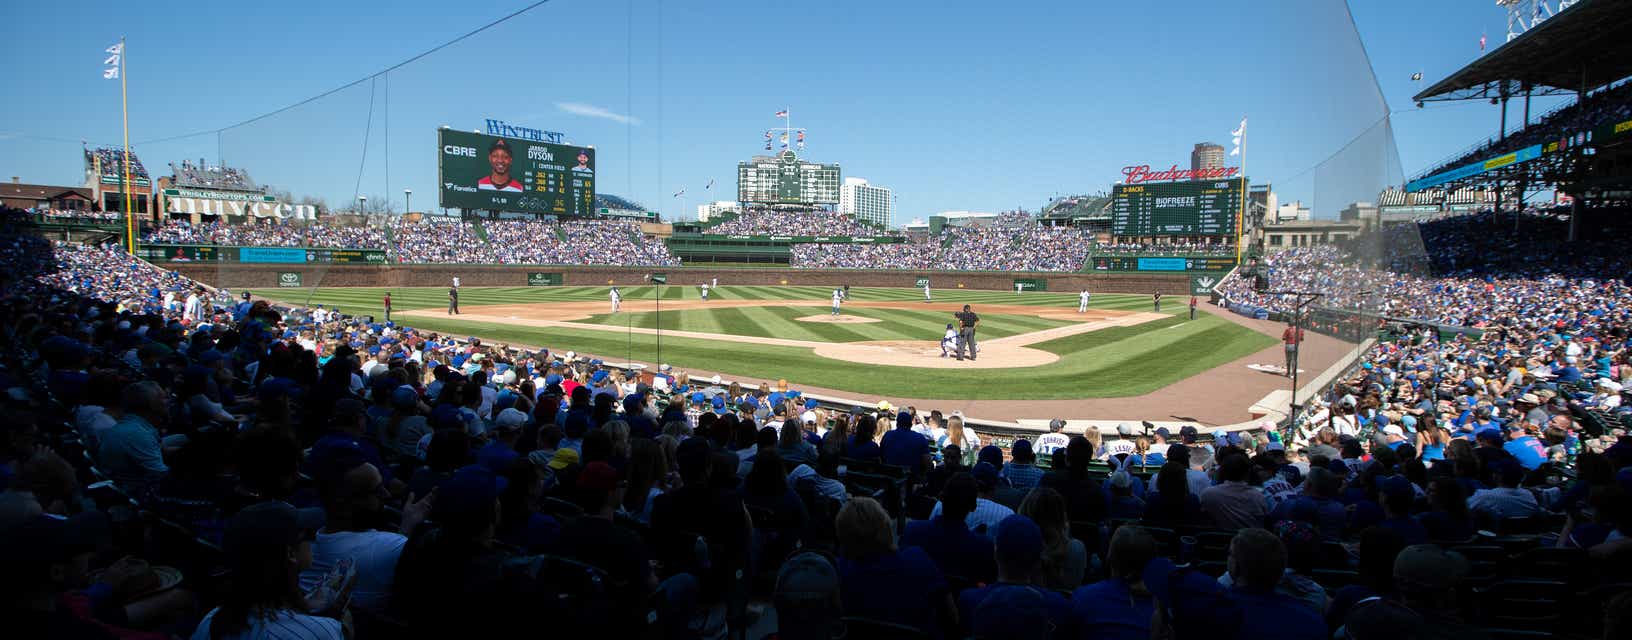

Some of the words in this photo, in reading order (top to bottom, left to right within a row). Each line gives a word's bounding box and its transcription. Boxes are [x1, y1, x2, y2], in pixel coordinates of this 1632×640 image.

[444, 145, 477, 158] CBRE
[528, 151, 554, 161] DYSON
[1121, 165, 1239, 183] Budweiser
[1155, 196, 1196, 205] BIOFREEZE
[171, 197, 318, 220] nuveen
